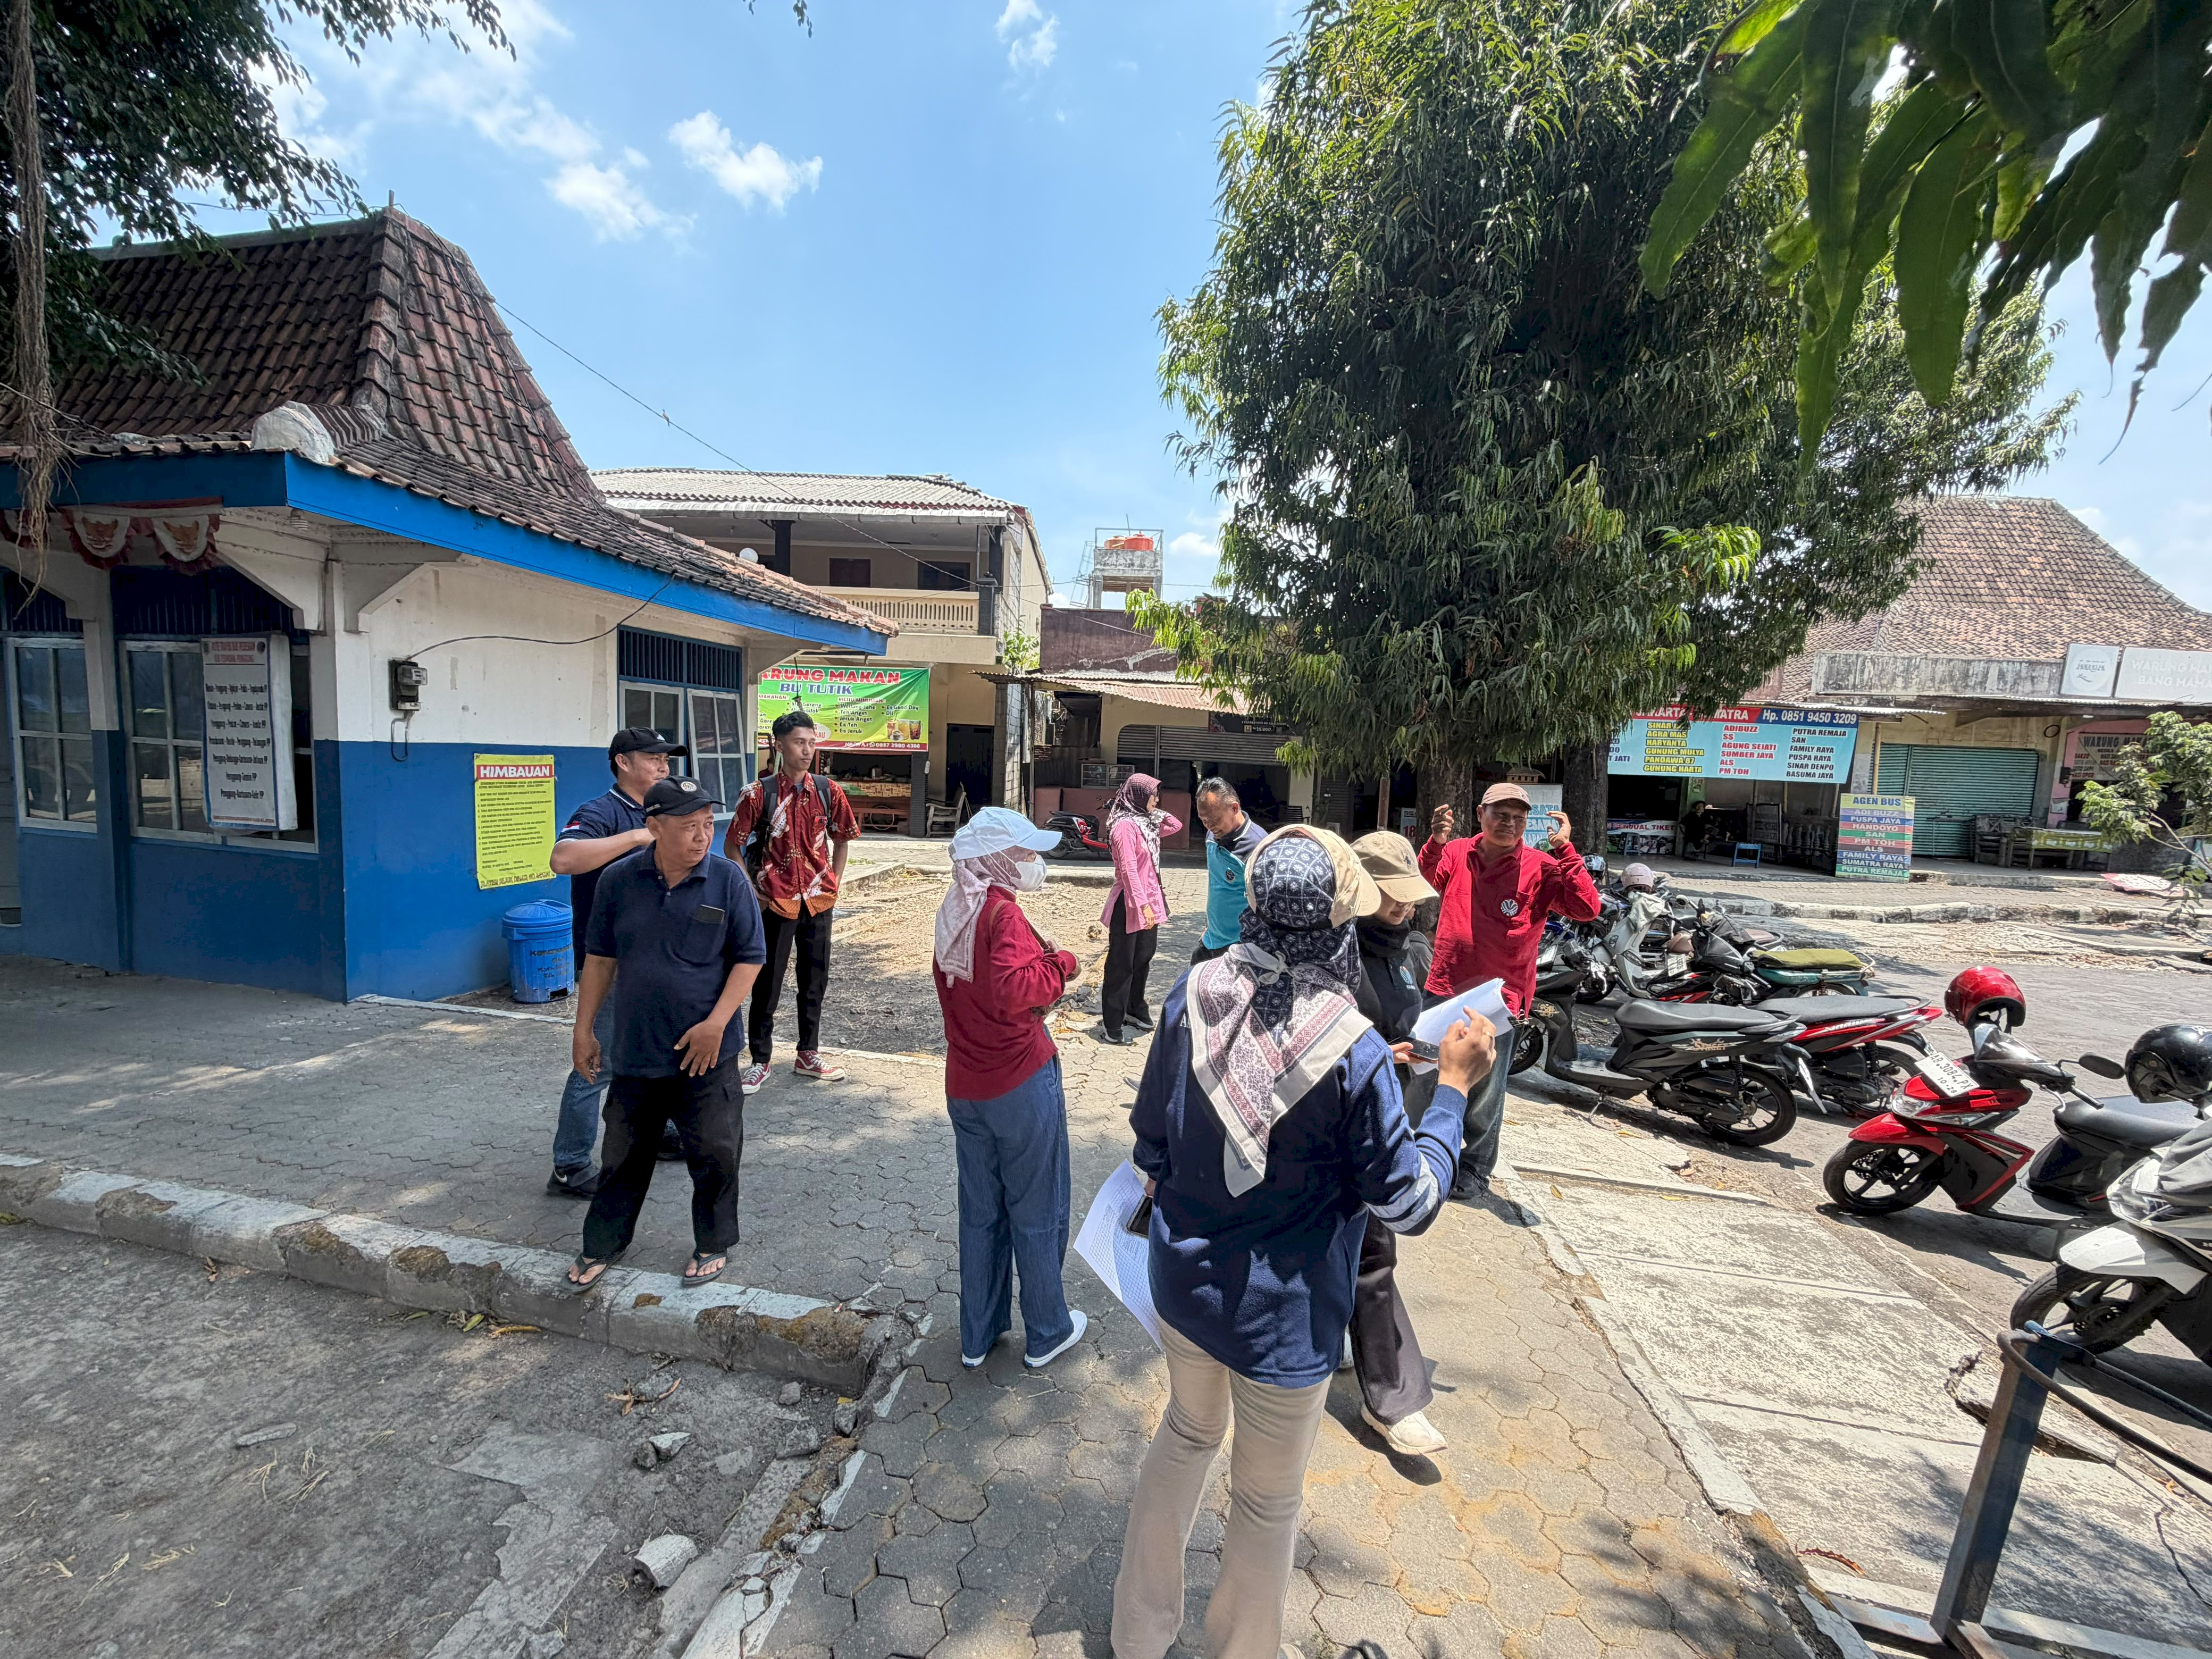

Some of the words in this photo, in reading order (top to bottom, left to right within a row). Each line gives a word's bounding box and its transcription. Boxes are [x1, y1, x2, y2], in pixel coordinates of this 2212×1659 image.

[2076, 664, 2105, 672] AQUA
[2132, 660, 2186, 673] WARUNG
[829, 669, 901, 685] MAKAN
[2138, 675, 2173, 686] BANG
[780, 683, 802, 693] BU
[808, 684, 852, 695] TUTIK
[1763, 709, 1779, 723] Hp.
[1781, 710, 1804, 722] 0851
[1807, 711, 1831, 723] 9450
[1833, 713, 1857, 724] 3209
[1669, 730, 1688, 739] MAS
[1646, 739, 1687, 747] HARYANTA
[2084, 736, 2119, 748] WARUNG
[1679, 748, 1704, 757] MULYA
[1644, 756, 1683, 764] PANDAWA
[480, 766, 550, 778] HIMBAUAN
[1643, 764, 1677, 773] GUNUNG
[1678, 765, 1703, 774] HARTA
[1853, 797, 1878, 805] AGEN
[1870, 868, 1904, 877] REMAJA
